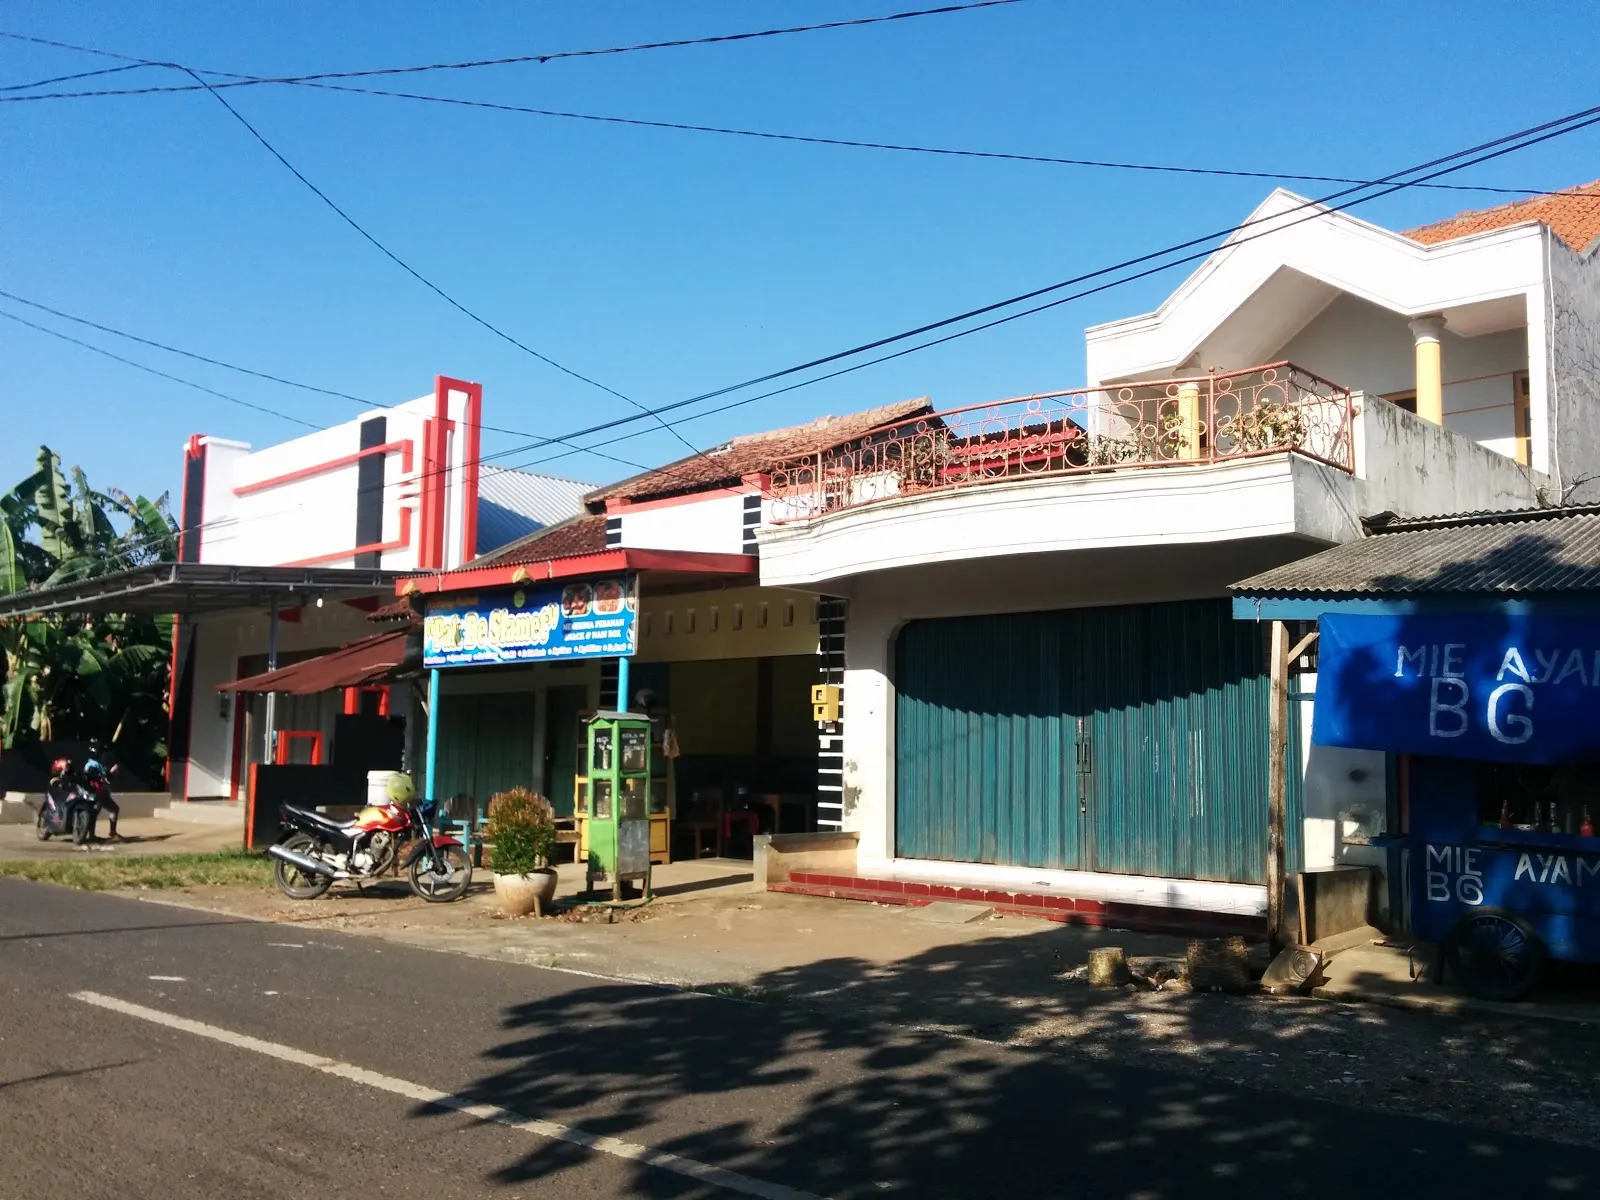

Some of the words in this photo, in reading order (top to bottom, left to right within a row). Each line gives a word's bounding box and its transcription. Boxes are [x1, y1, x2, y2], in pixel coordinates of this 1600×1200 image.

[466, 612, 487, 649] De
[1394, 643, 1466, 678] MIE
[1496, 647, 1600, 687] AYA
[1426, 844, 1482, 877] MIE
[1426, 871, 1484, 906] BG
